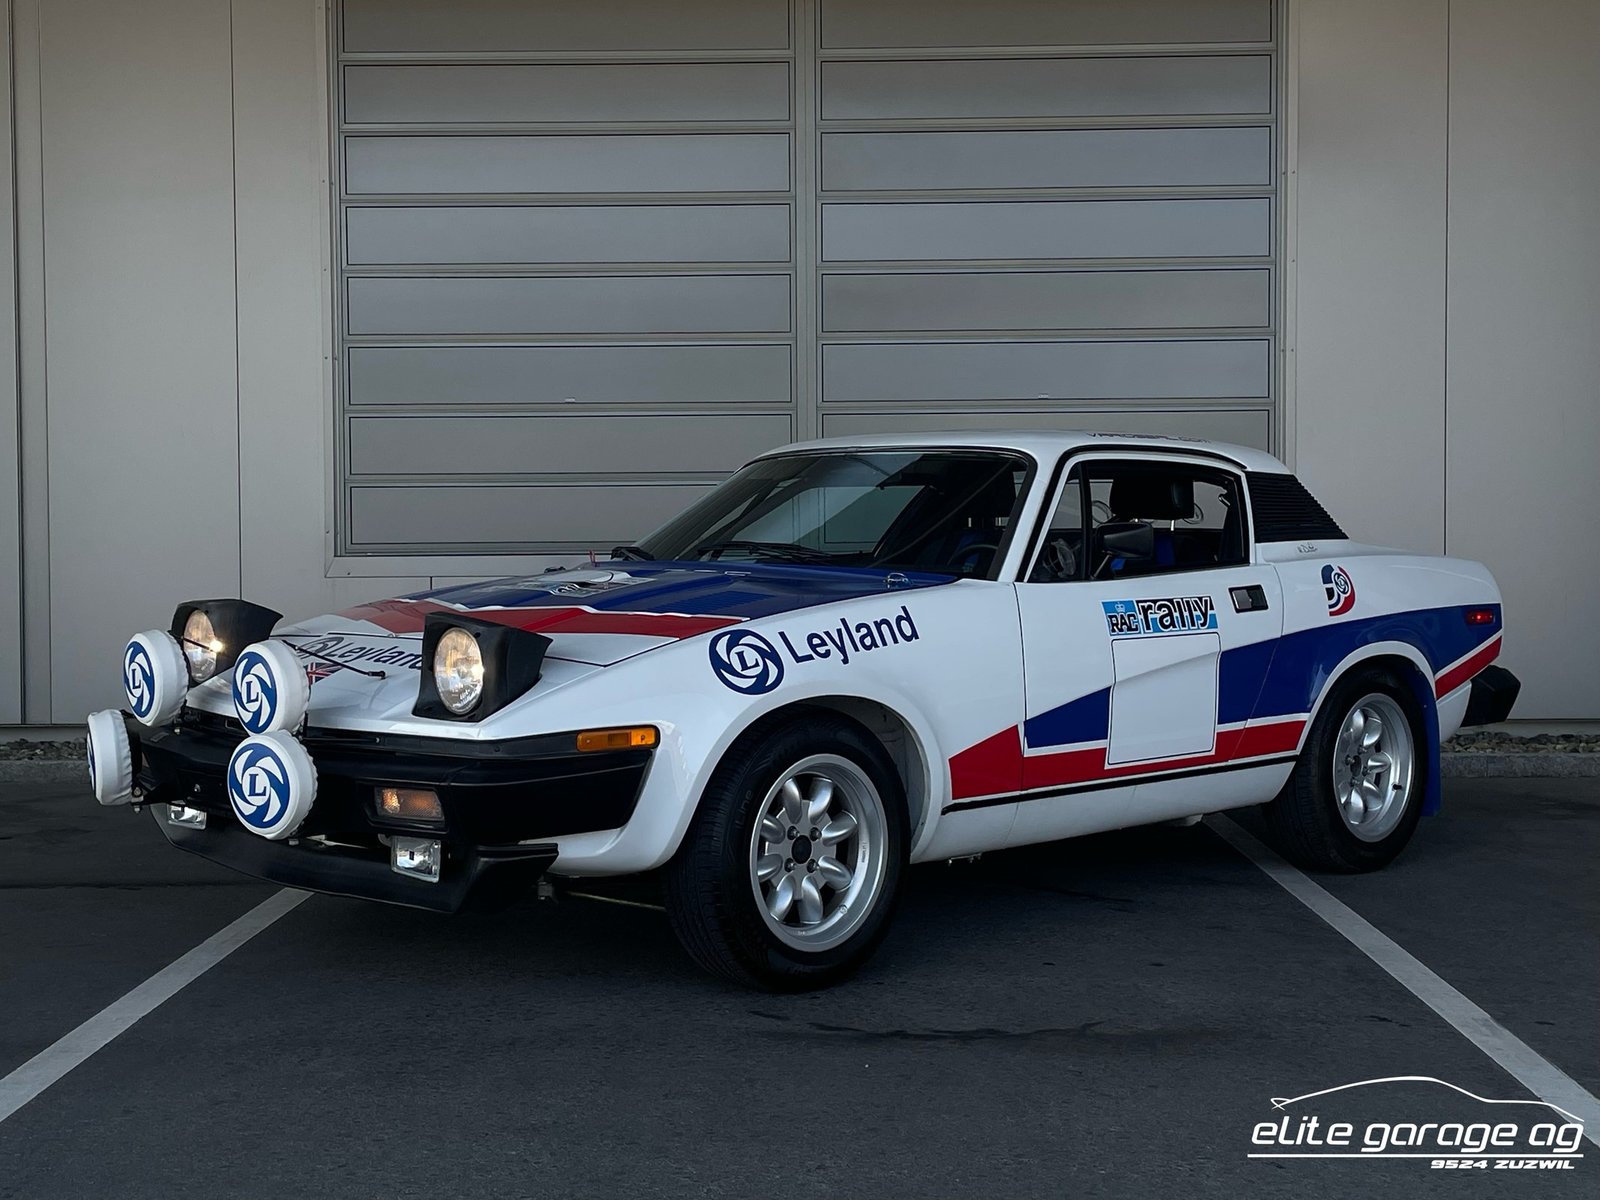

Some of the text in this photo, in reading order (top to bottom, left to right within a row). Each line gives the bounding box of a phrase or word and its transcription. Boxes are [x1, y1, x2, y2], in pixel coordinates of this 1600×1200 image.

[1107, 597, 1210, 634] RAC rally
[735, 605, 920, 672] L Leyland
[131, 668, 142, 690] L
[245, 680, 259, 704] L
[248, 773, 267, 797] L
